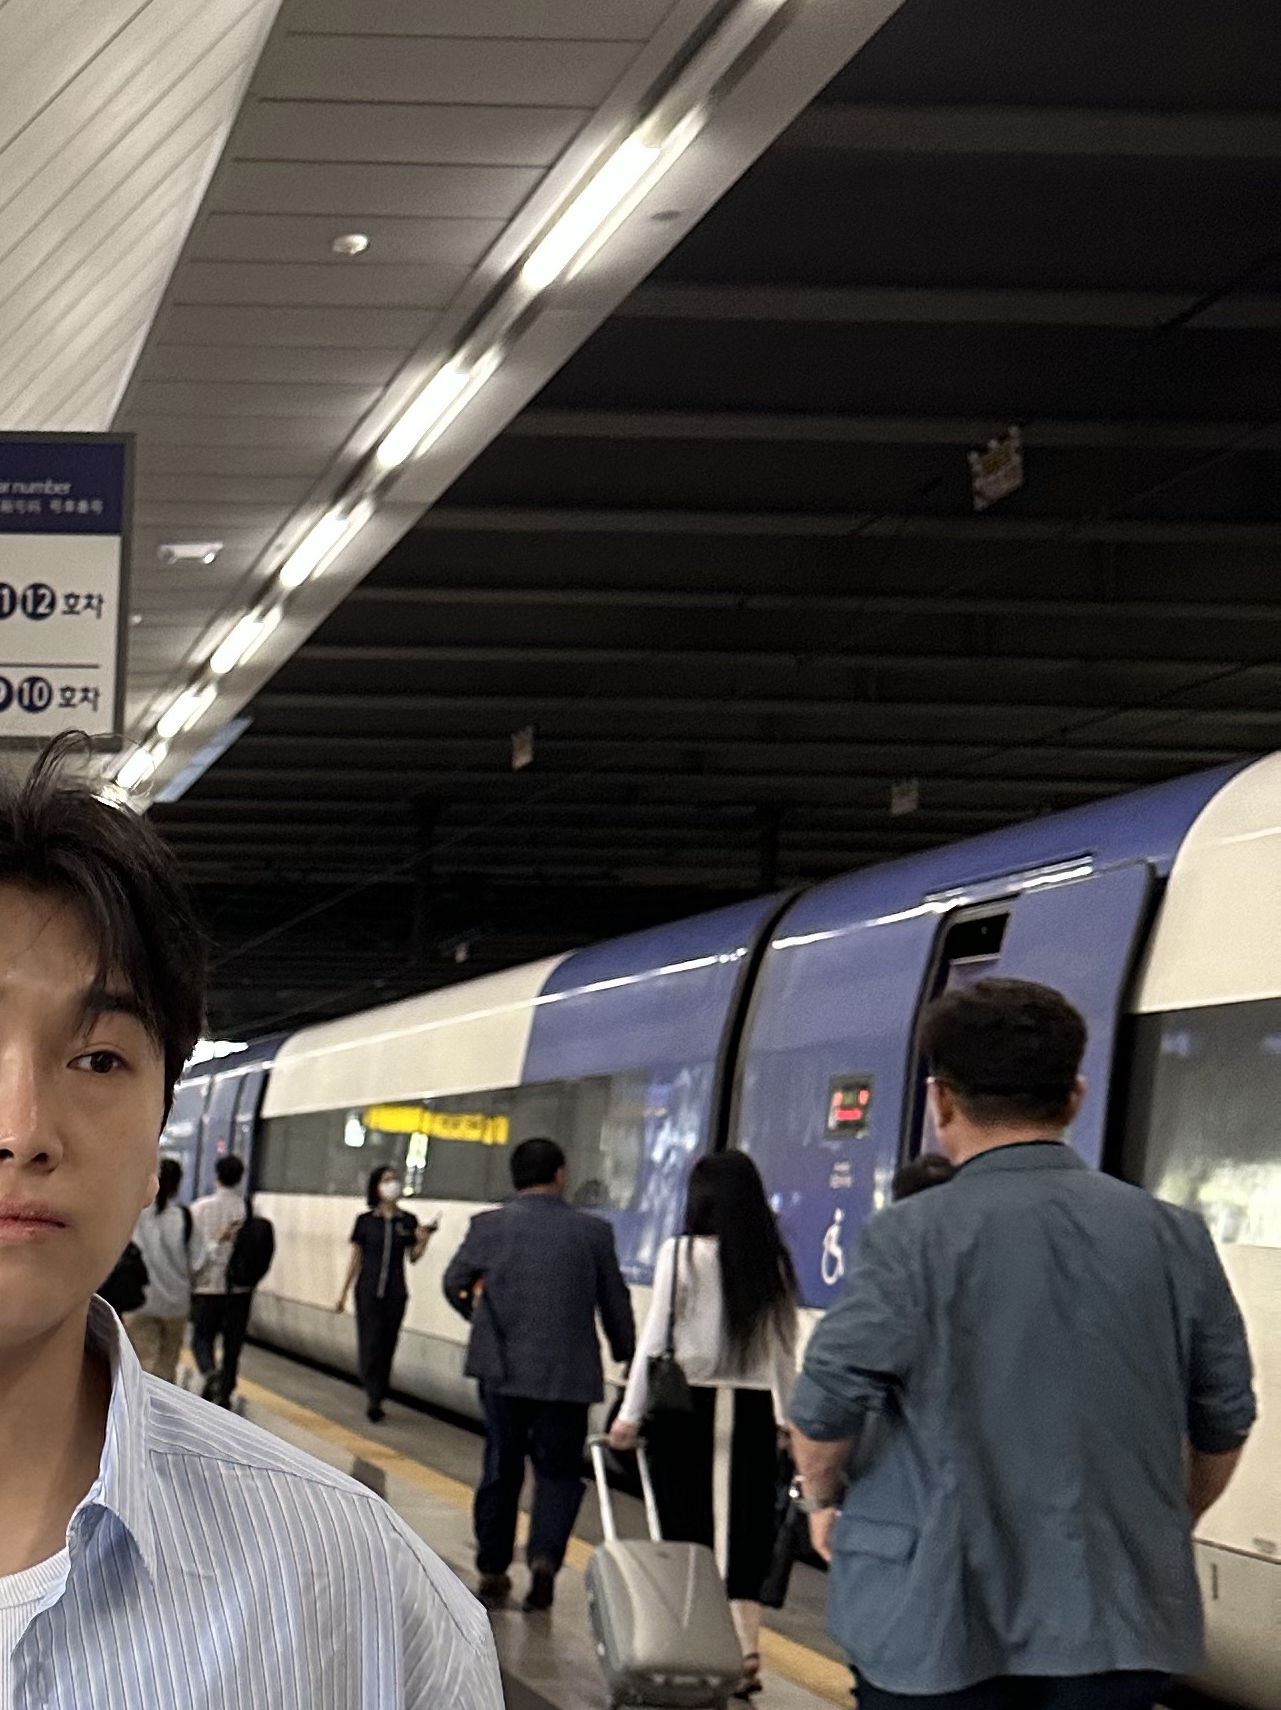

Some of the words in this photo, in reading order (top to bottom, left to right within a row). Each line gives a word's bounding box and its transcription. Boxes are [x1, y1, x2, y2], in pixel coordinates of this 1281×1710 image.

[22, 586, 53, 617] 12
[61, 592, 104, 619] 호차
[20, 679, 51, 709] 10
[58, 685, 100, 712] 호차
